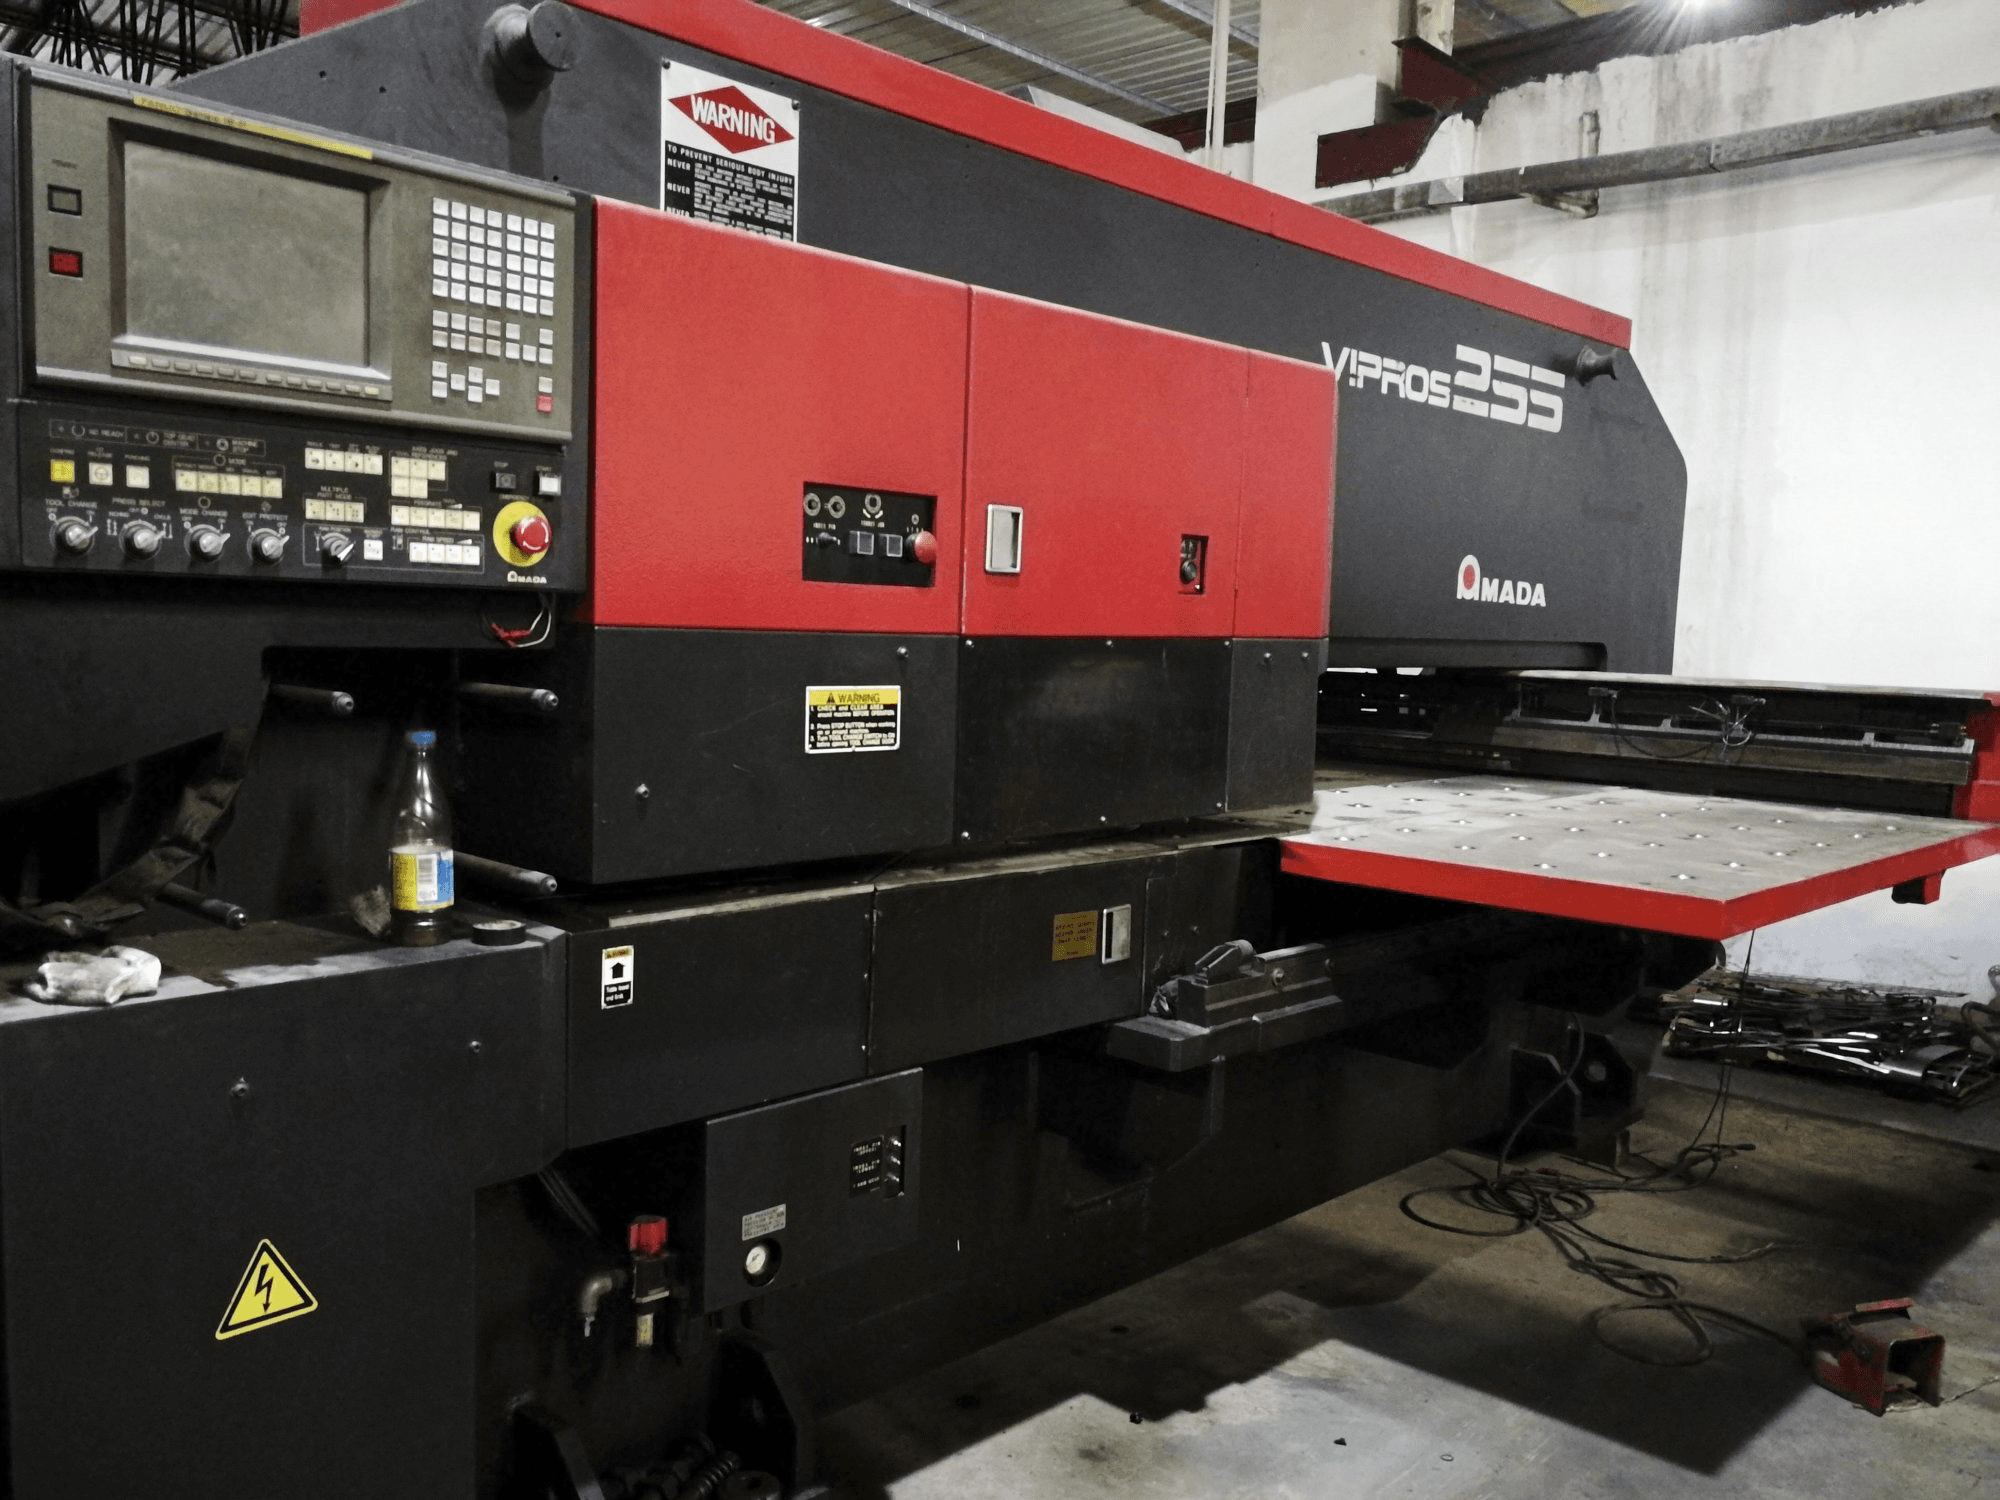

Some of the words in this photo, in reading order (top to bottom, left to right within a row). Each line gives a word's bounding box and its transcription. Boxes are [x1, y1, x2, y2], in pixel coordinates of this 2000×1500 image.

[690, 94, 776, 143] WARNING
[667, 144, 677, 153] TO
[680, 147, 712, 163] PREVENT
[715, 157, 745, 172] SERIOUS
[747, 166, 765, 178] BODY
[768, 171, 793, 185] INJURY
[667, 158, 691, 171] NEVER
[667, 182, 691, 195] NEVER
[1321, 341, 1452, 408] VIPROS
[1453, 343, 1566, 433] 255
[1456, 554, 1547, 607] AMADA
[838, 692, 881, 704] WARNING
